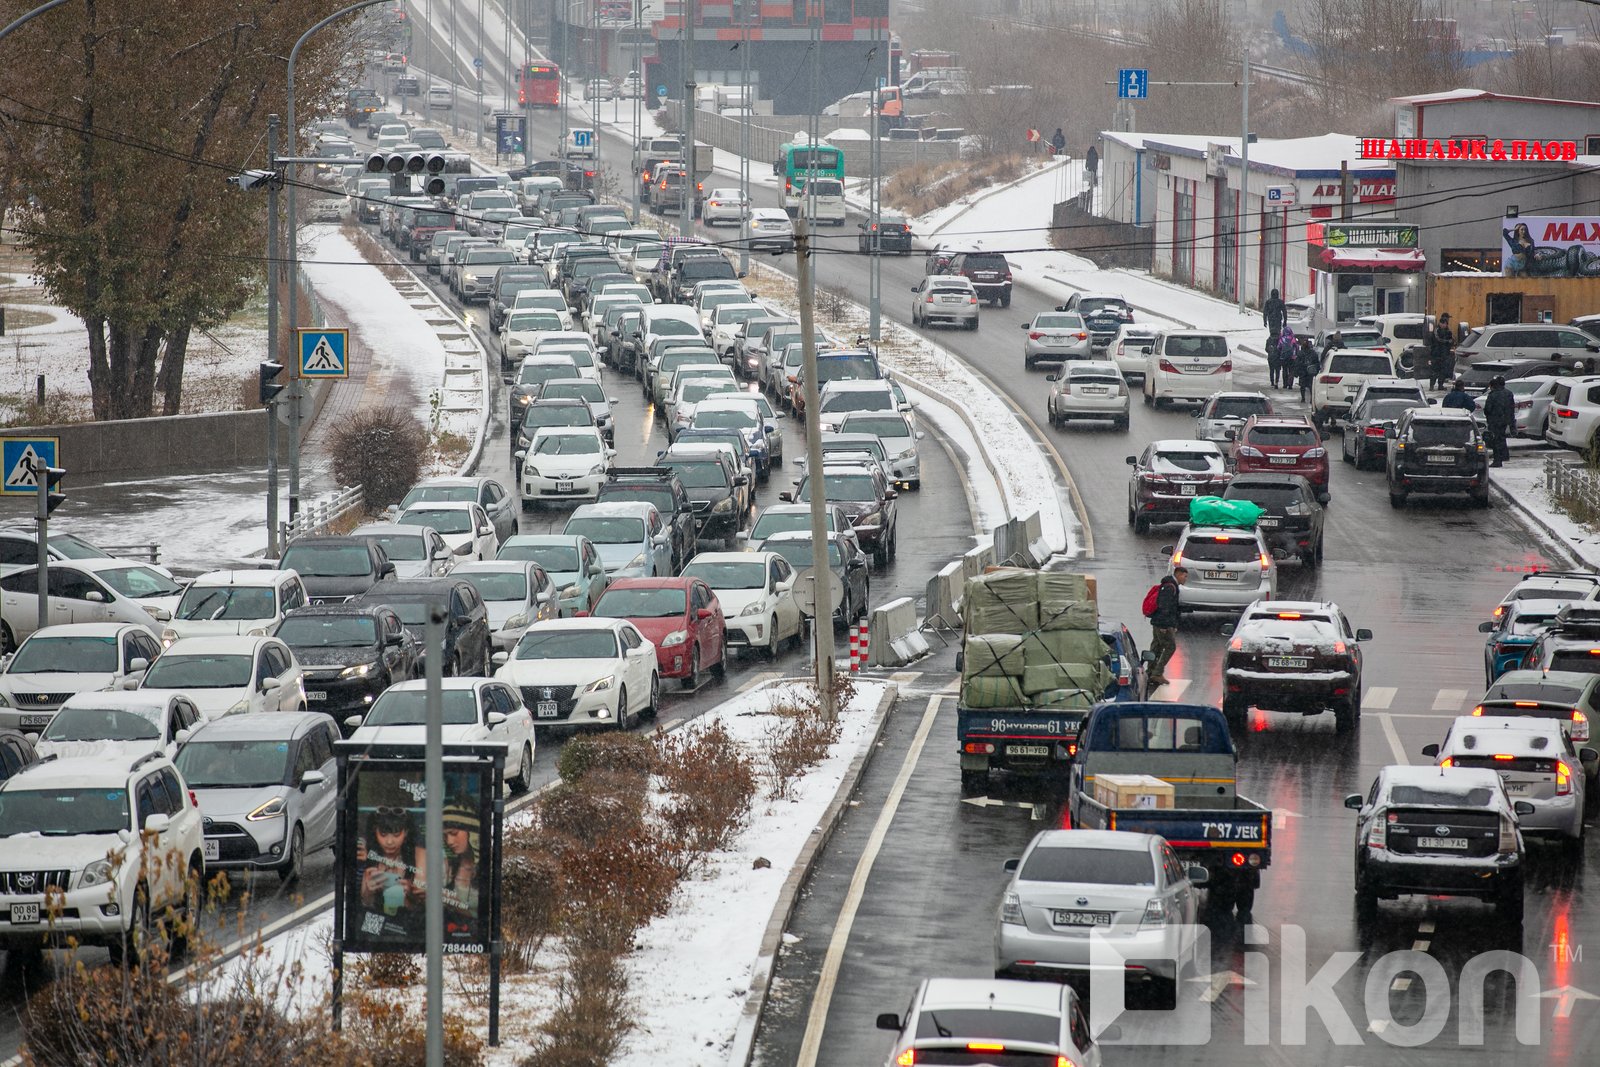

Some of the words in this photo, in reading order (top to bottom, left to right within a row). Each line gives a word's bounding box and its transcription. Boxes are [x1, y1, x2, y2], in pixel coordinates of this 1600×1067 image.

[1362, 138, 1487, 160] ШАШЛЫК
[1510, 140, 1577, 161] ПЛОВ
[1349, 229, 1399, 244] ШАШЛЫК
[991, 718, 1006, 732] 96
[1047, 720, 1061, 733] 61
